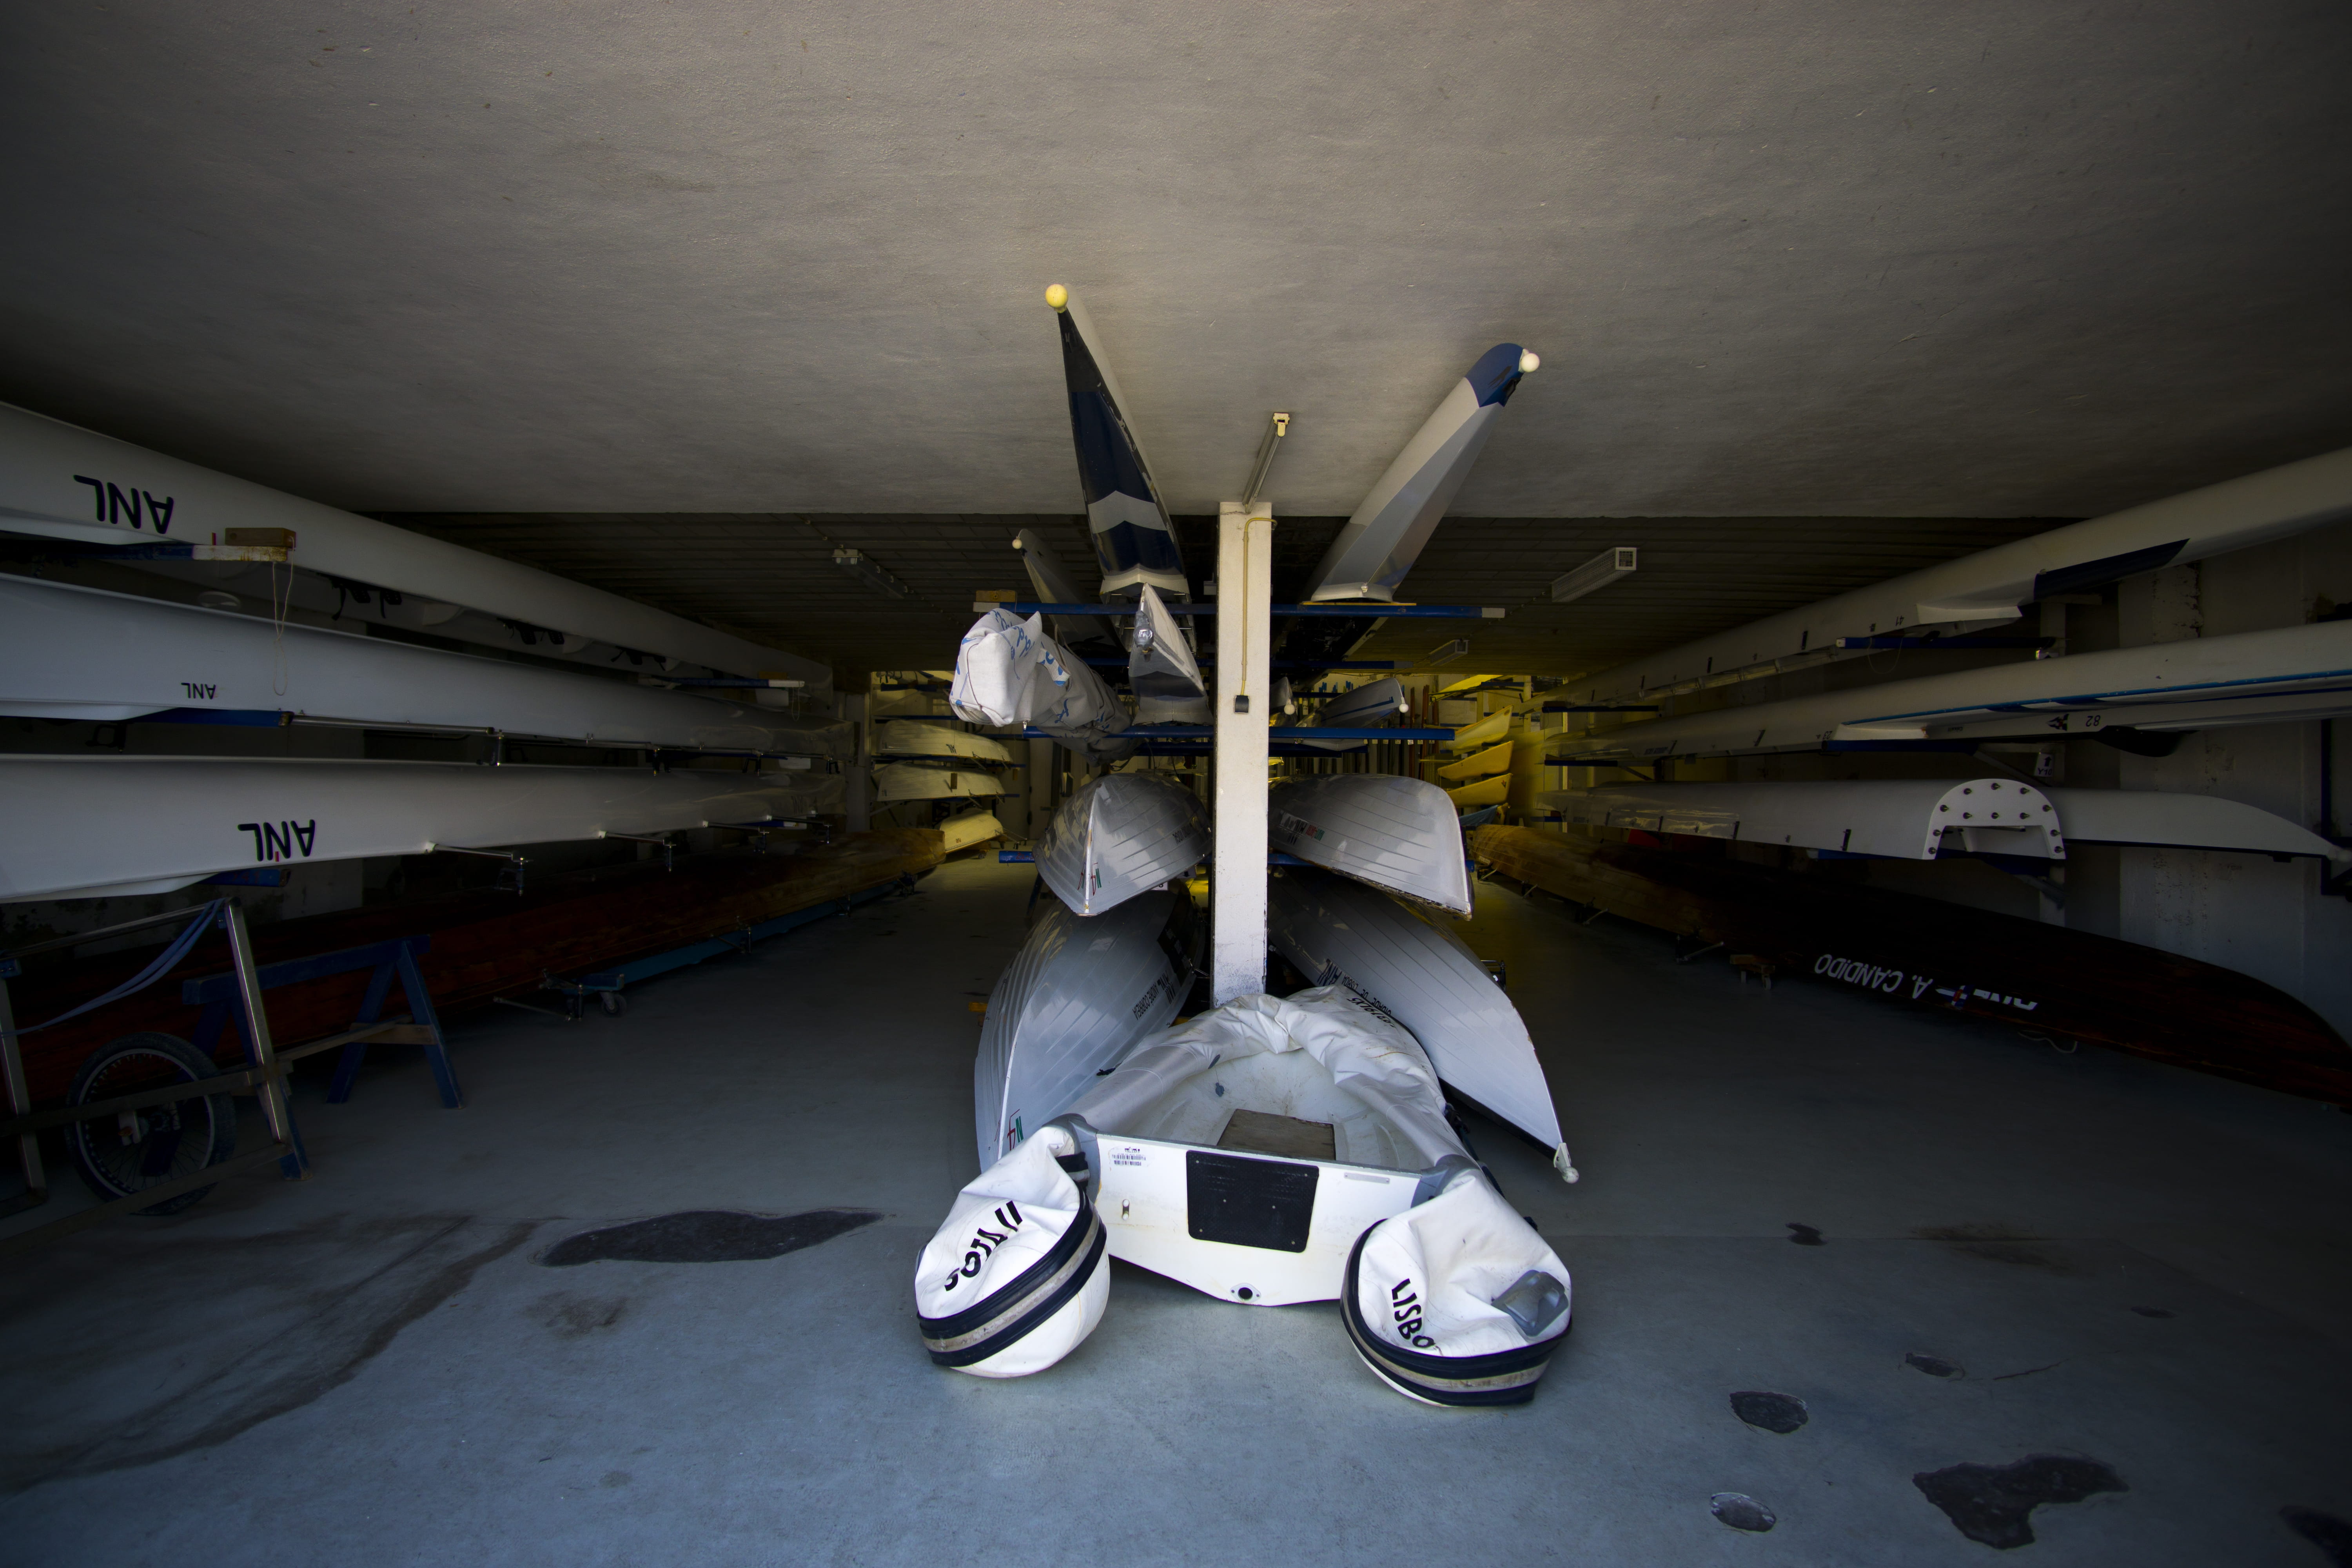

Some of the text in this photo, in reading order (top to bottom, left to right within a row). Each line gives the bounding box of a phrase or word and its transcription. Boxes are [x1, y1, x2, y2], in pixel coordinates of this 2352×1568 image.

[73, 474, 174, 534] ANL
[1895, 615, 1904, 626] 41
[181, 682, 216, 699] ANL
[2085, 715, 2101, 727] 82
[238, 819, 315, 862] ANL
[1814, 953, 1904, 993] CANDIDO
[1912, 975, 1934, 1000] A.
[1132, 995, 1151, 1022] CORREIA
[1391, 1278, 1442, 1355] LISBO
